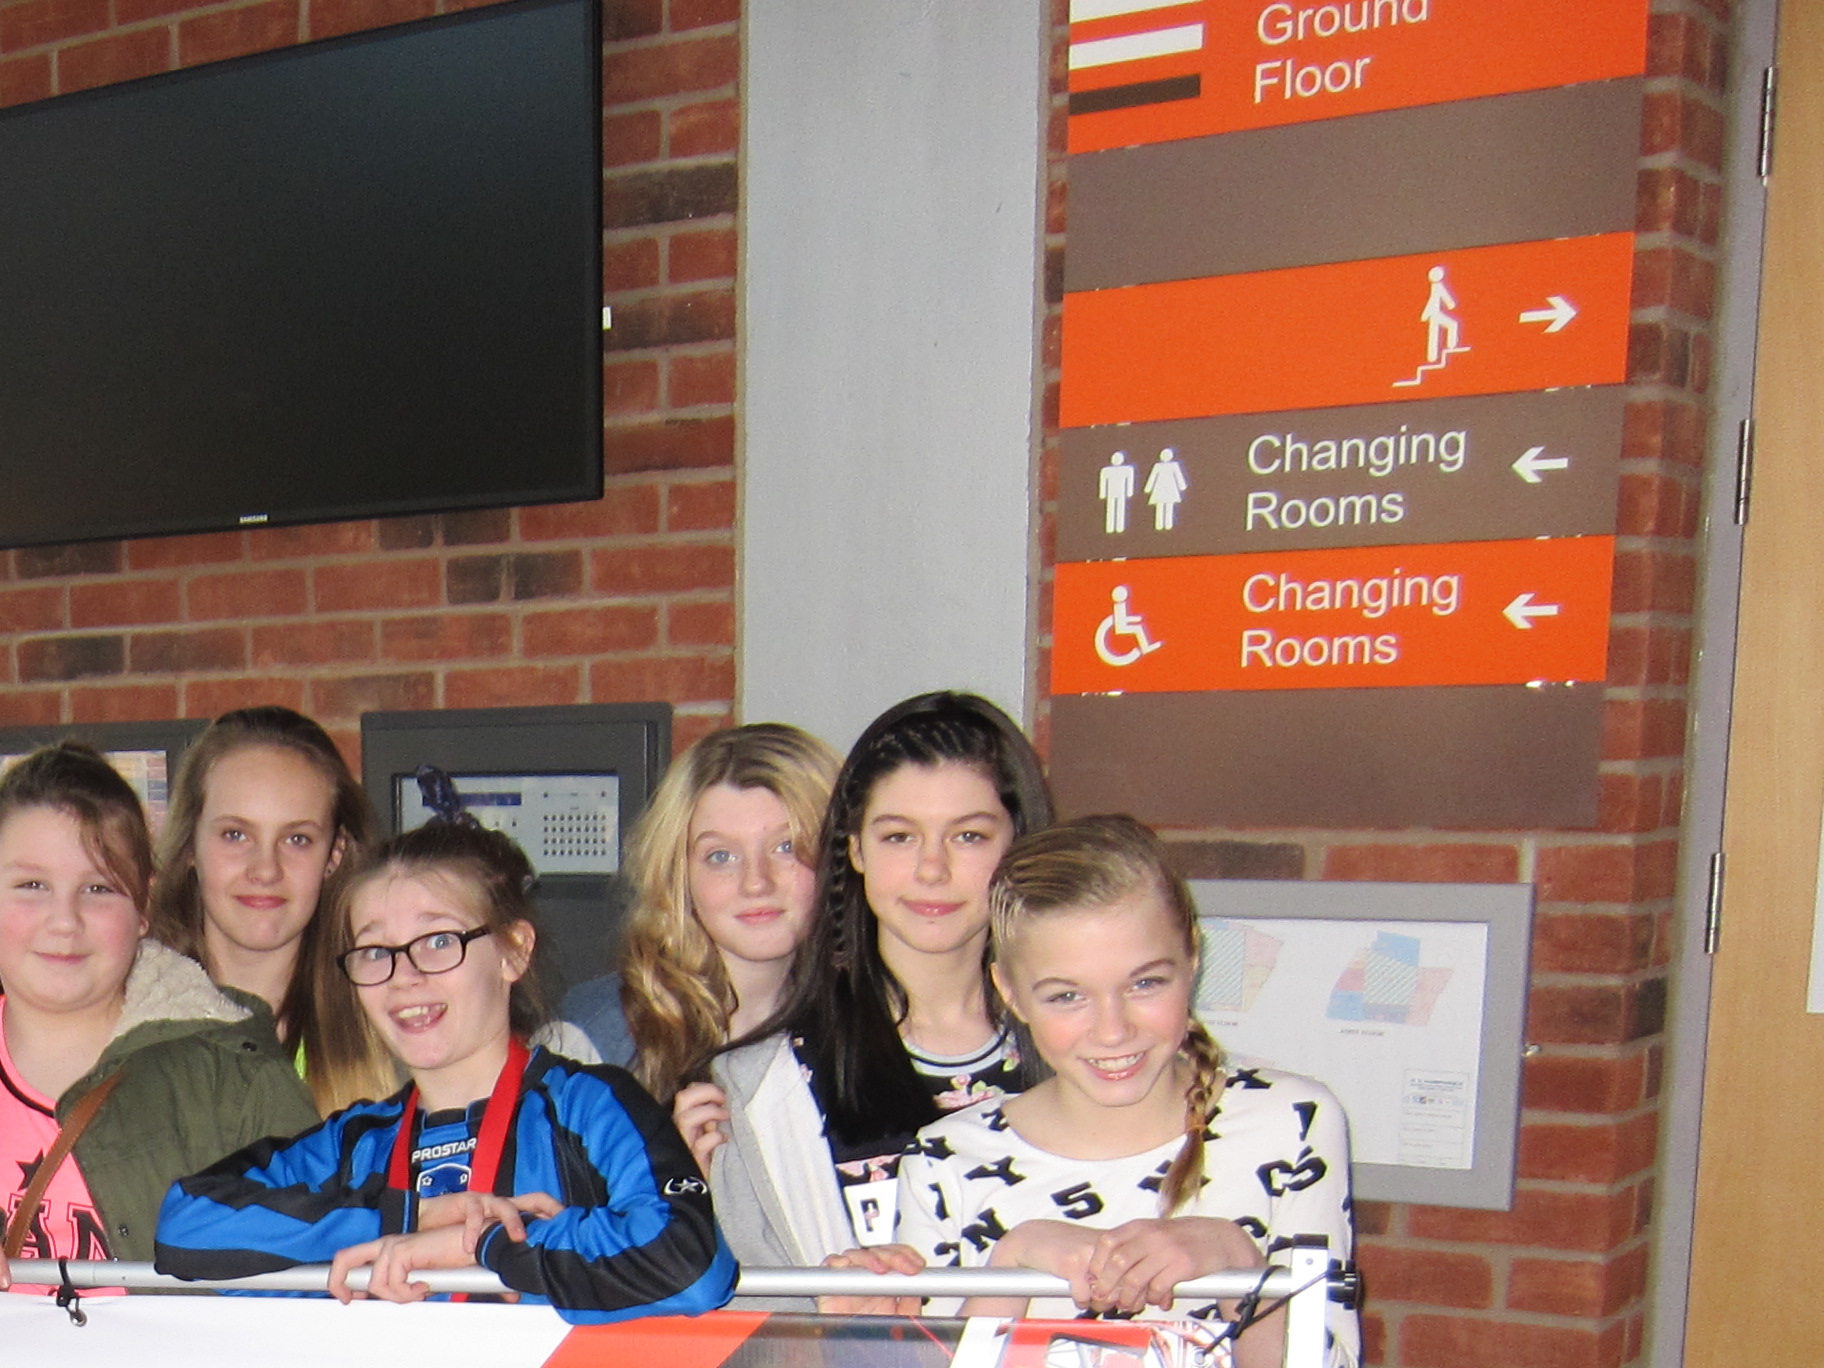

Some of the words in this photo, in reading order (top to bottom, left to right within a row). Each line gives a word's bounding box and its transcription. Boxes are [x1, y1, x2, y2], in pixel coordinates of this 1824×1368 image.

[1257, 0, 1428, 45] Ground
[1254, 57, 1372, 103] Floor
[1248, 424, 1467, 477] Changing
[1246, 491, 1405, 531] Rooms
[1242, 567, 1460, 619] Changing
[1241, 629, 1399, 668] Rooms
[411, 1137, 477, 1163] PROSTAR
[1050, 1181, 1104, 1220] 5
